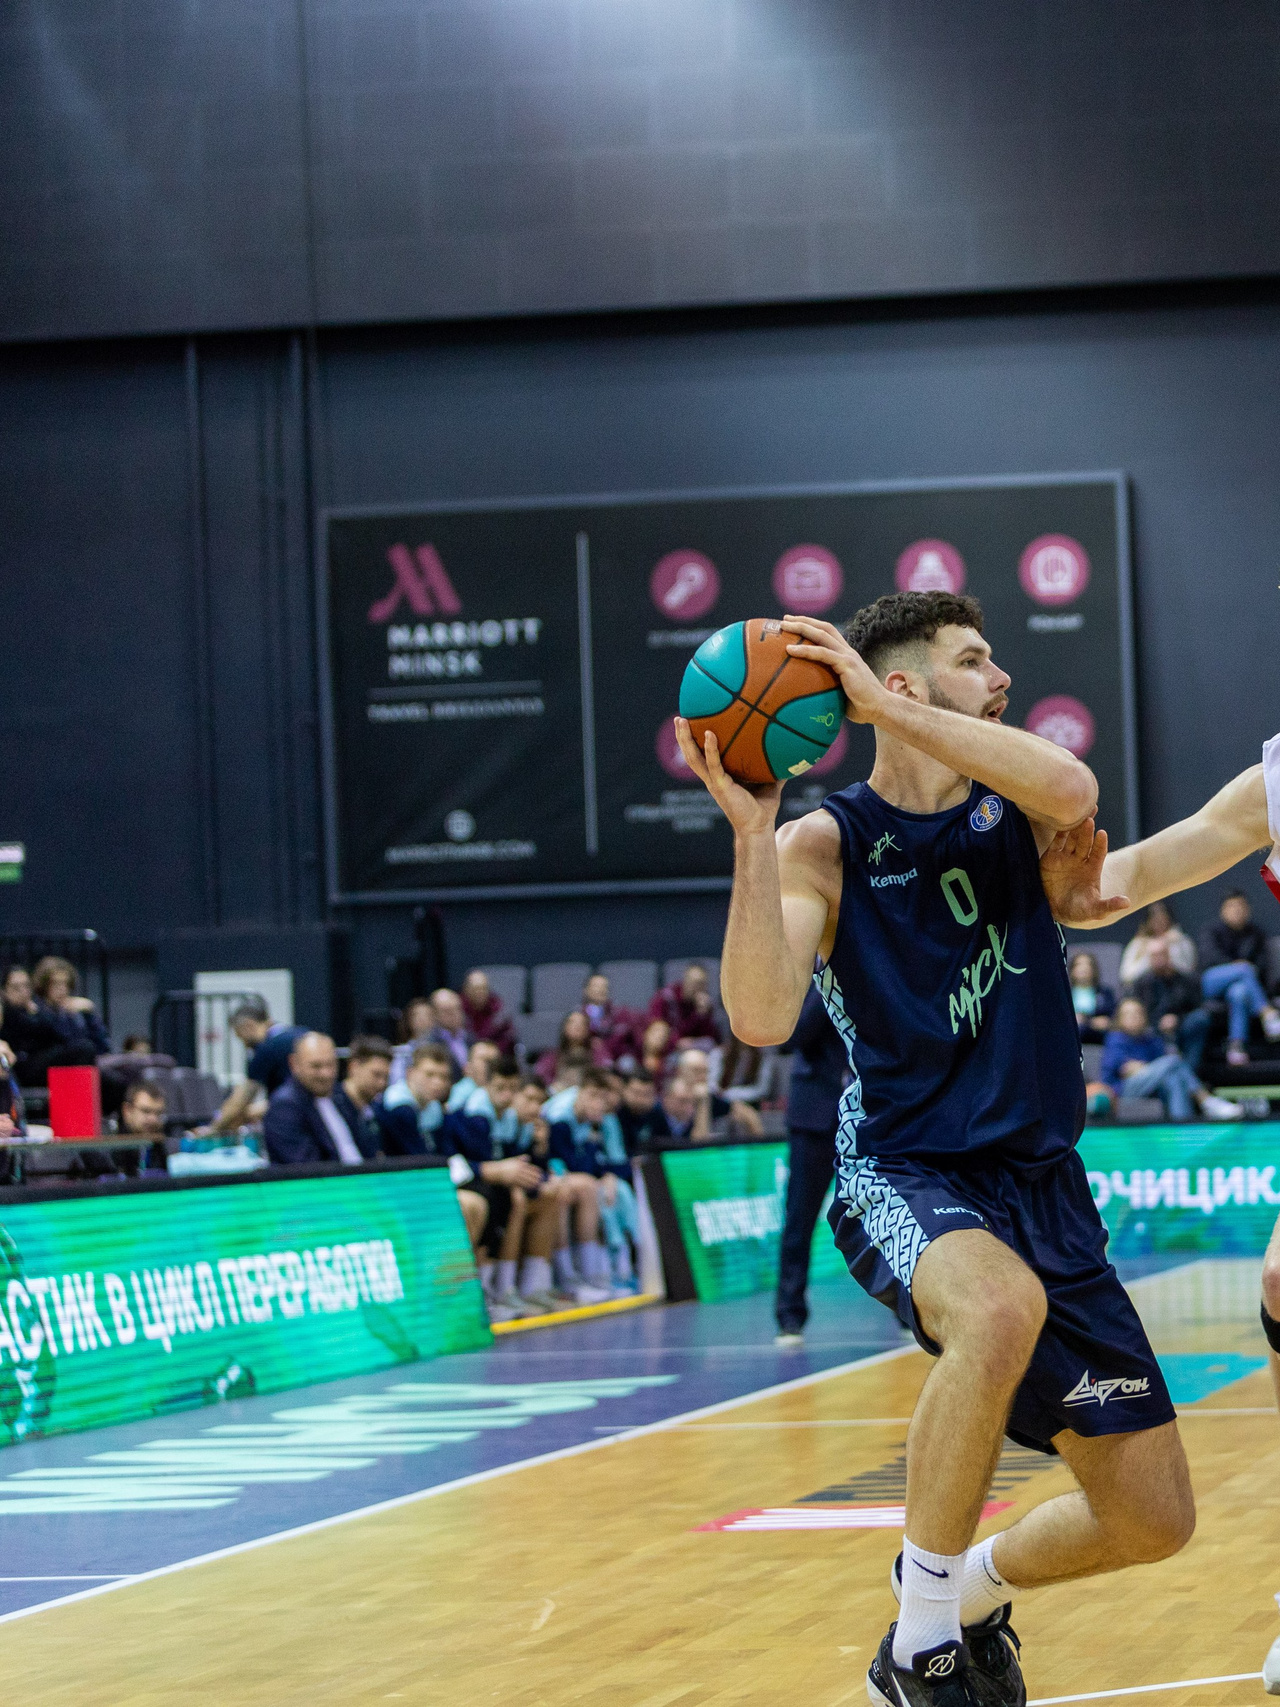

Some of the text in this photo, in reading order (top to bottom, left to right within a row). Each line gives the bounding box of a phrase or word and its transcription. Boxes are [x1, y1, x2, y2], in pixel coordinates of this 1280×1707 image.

[386, 617, 541, 651] MARRIOTT
[388, 649, 483, 681] MINSK
[870, 867, 918, 888] Kempa
[940, 867, 979, 927] 0
[104, 1273, 137, 1346] В
[131, 1261, 226, 1354] ЦИКЛ
[217, 1238, 405, 1326] ПЕРЕРАБОТКИ
